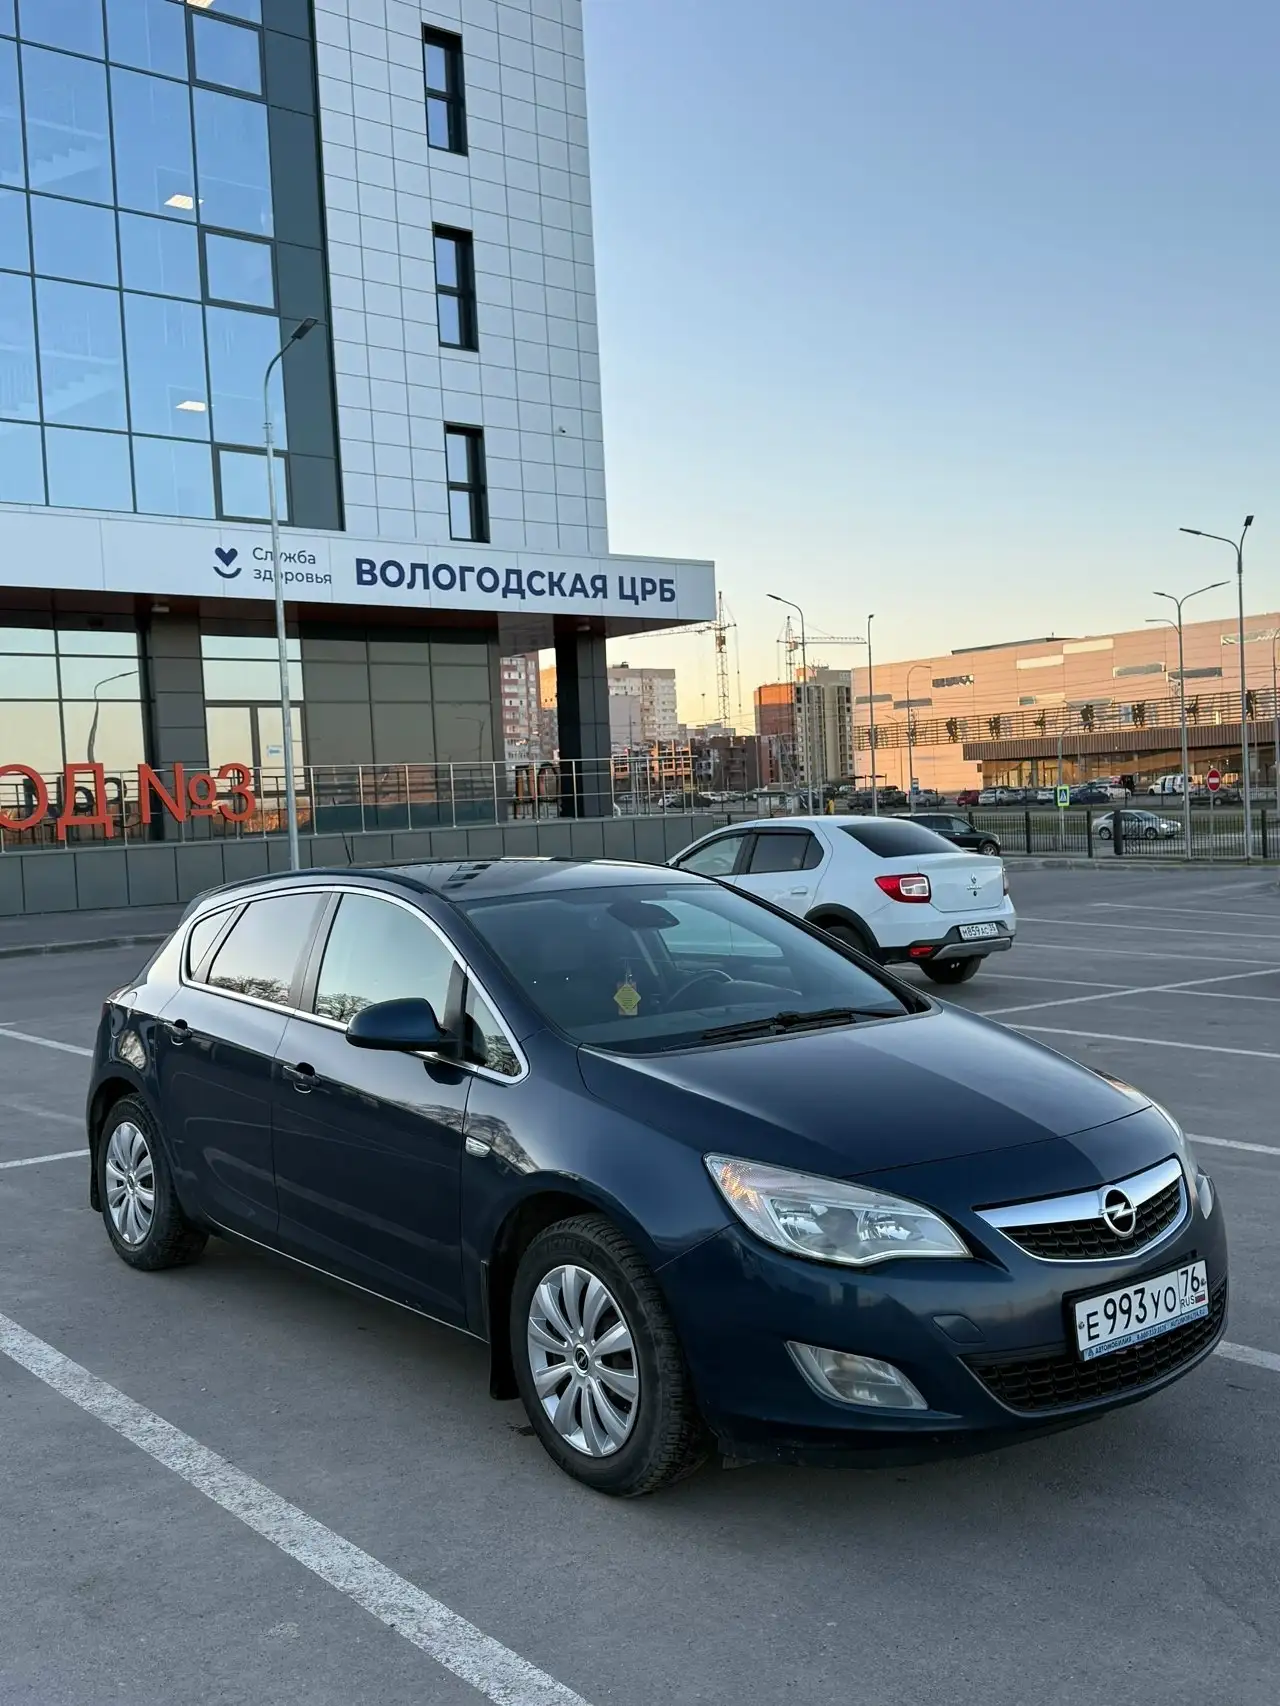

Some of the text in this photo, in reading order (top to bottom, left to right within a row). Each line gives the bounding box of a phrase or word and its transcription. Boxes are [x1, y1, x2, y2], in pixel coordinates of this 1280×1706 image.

[355, 557, 676, 605] ВОЛОГОДСКАЯ ЦРБ
[1086, 1286, 1177, 1342] Е993УО
[1180, 1295, 1195, 1308] RUS
